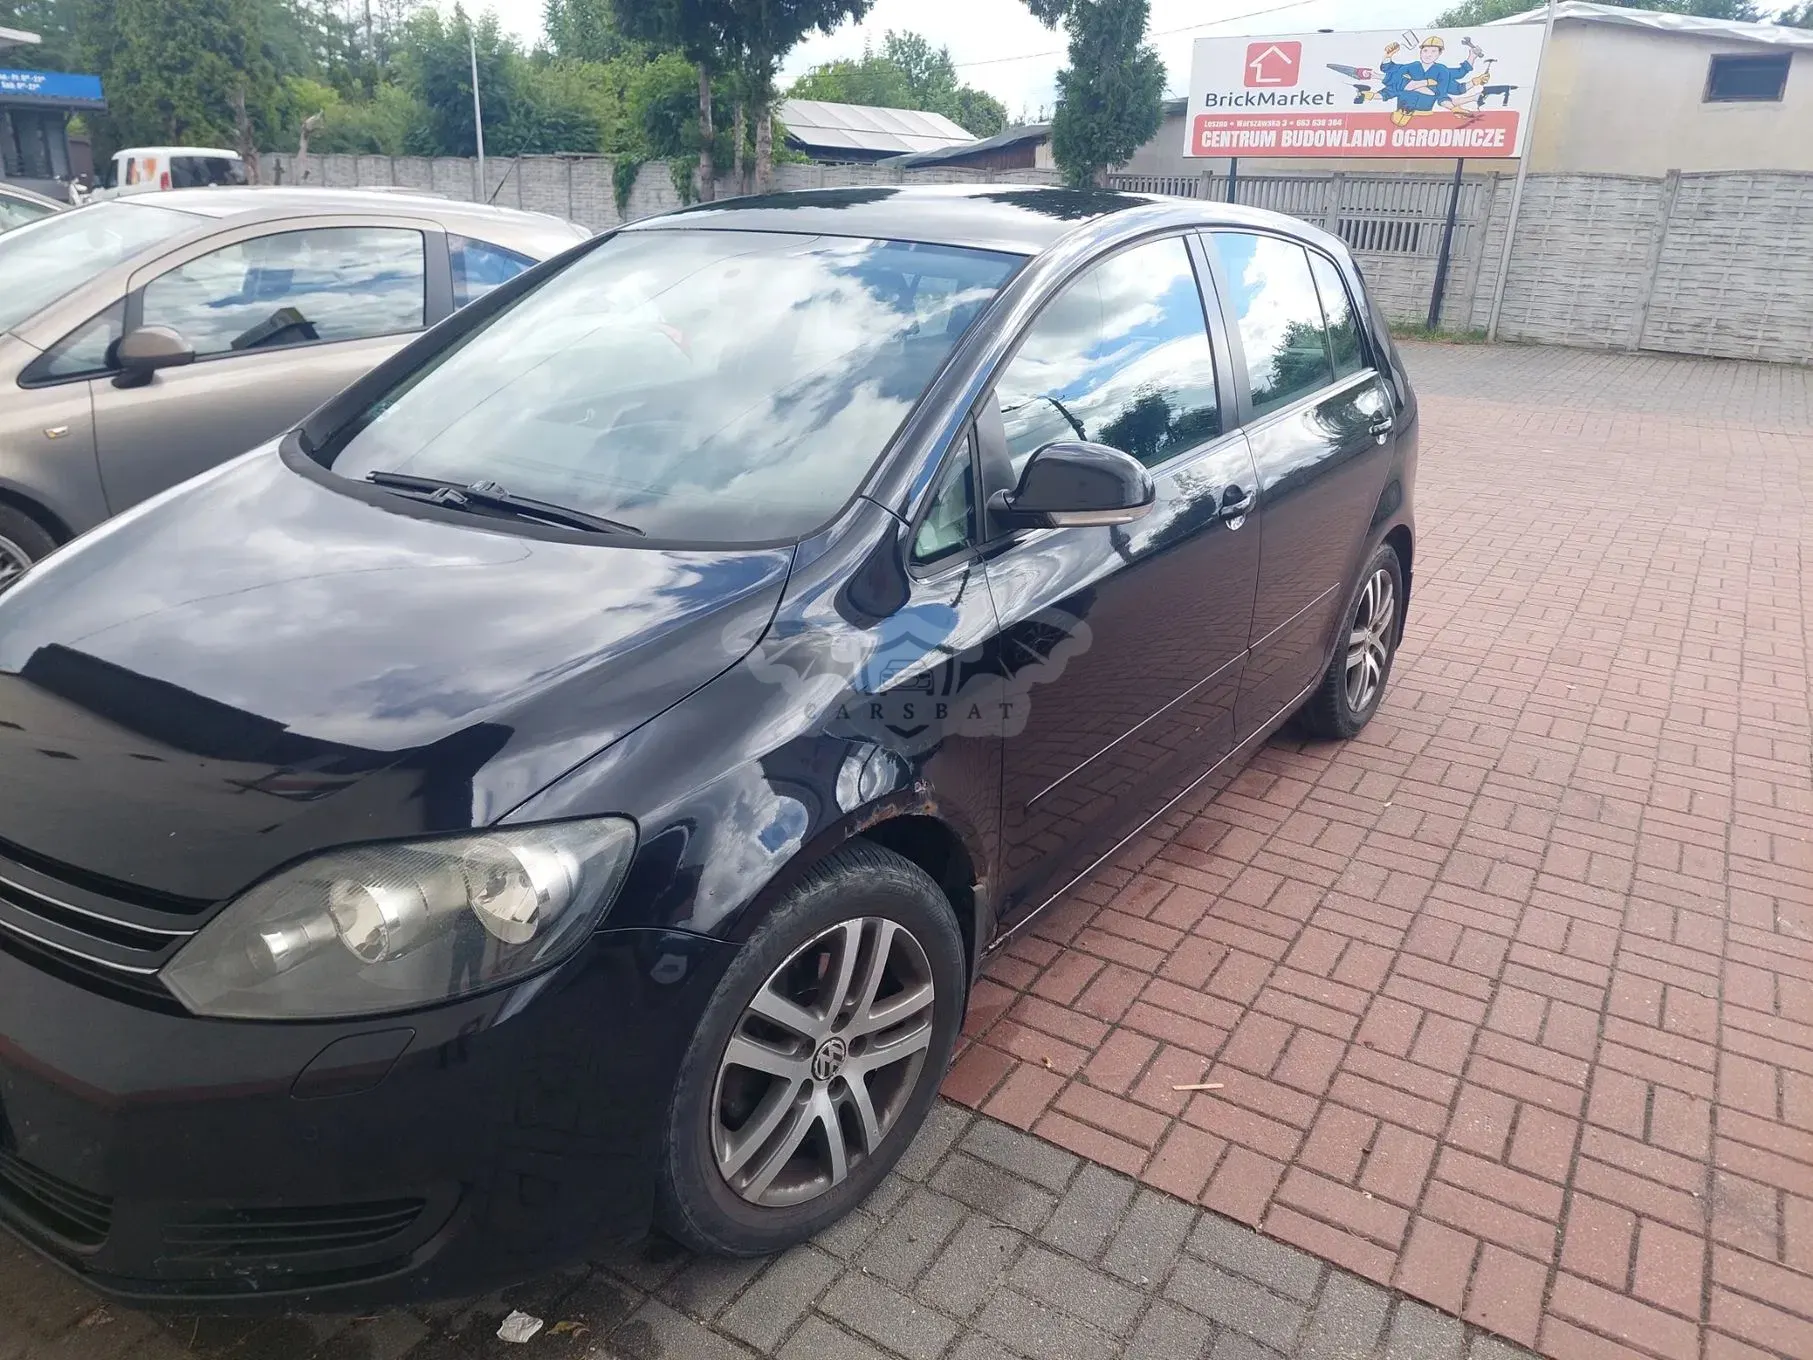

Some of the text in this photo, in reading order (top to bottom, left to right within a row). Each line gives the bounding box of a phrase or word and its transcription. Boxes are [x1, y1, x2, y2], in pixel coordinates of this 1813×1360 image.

[1205, 90, 1335, 107] BrickMarket
[1201, 128, 1506, 147] CENTRUM BUDOWLANO OGRODNICZE
